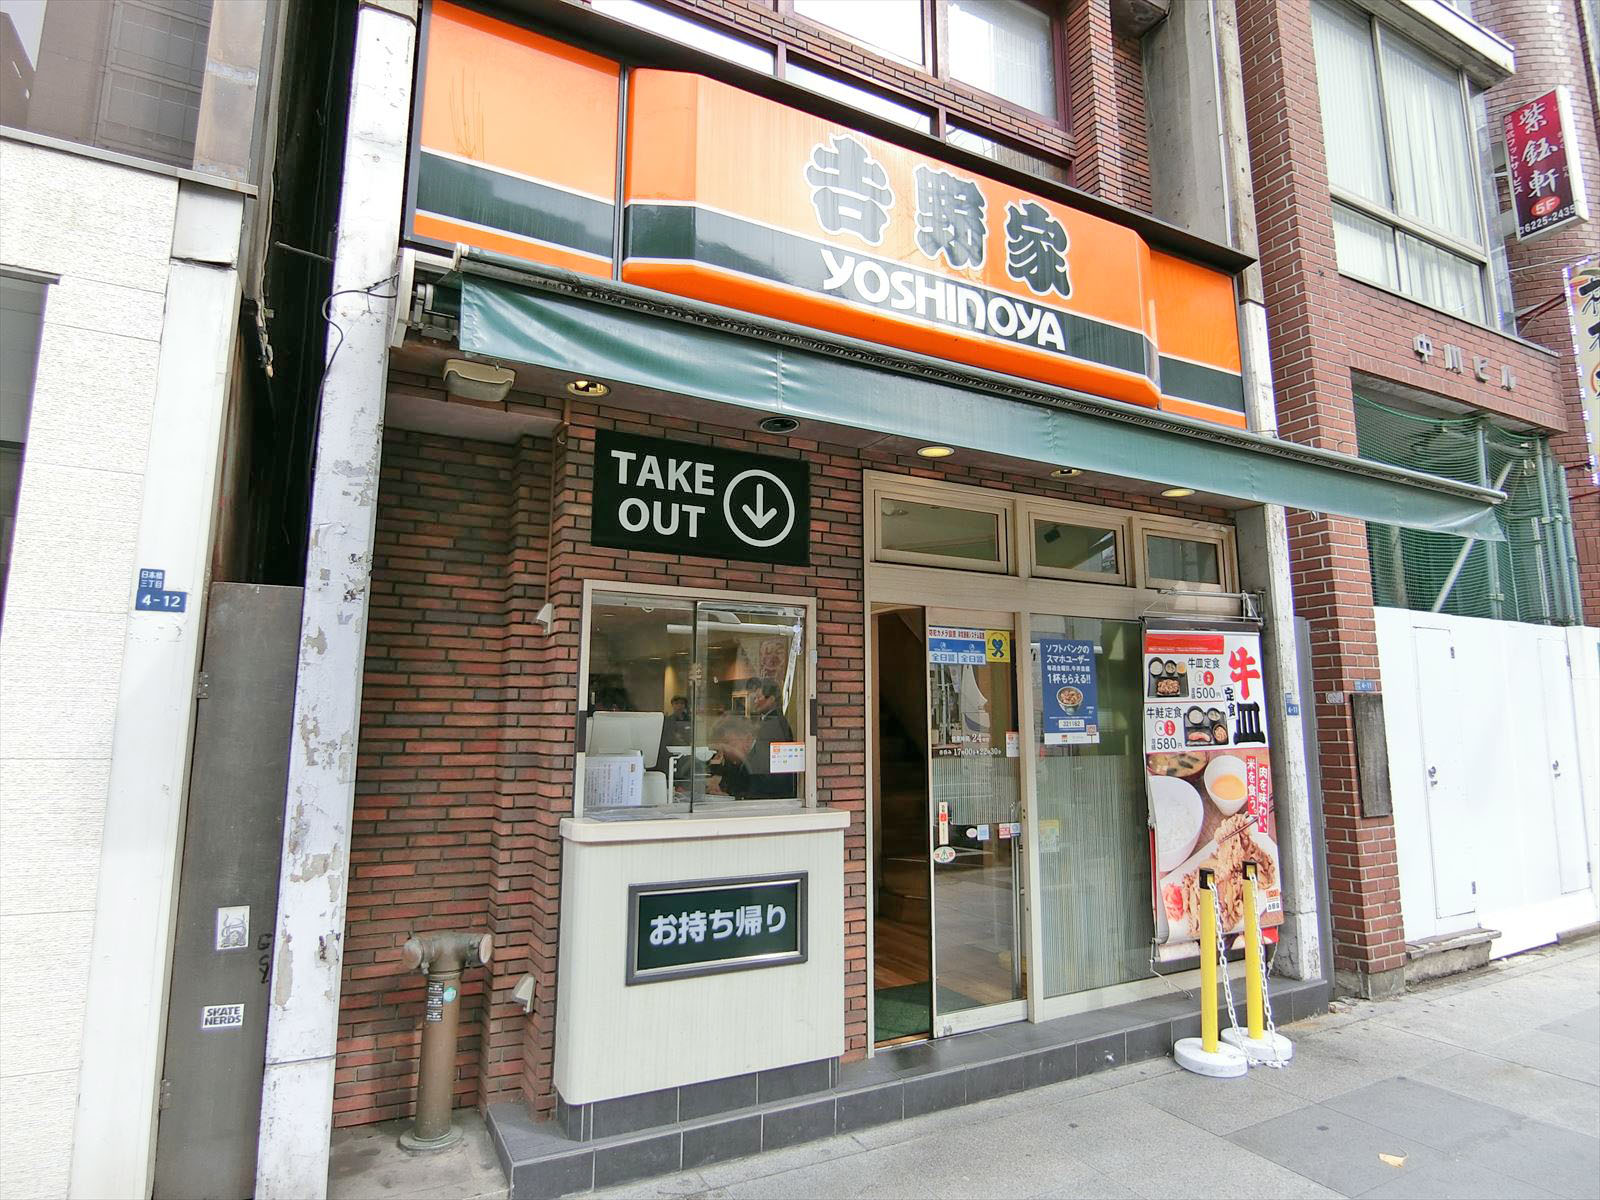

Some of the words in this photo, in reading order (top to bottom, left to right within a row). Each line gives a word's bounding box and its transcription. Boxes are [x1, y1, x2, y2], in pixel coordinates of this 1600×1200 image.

[1535, 197, 1556, 216] 5F
[804, 133, 1072, 300] 吉野家
[611, 450, 715, 496] TAKE
[618, 498, 705, 538] OUT
[140, 580, 162, 588] 三丁目
[142, 594, 181, 607] 4-12
[1045, 643, 1090, 654] ソフトバンクの
[1046, 654, 1090, 664] スマホユーザー
[1188, 657, 1220, 669] 牛皿定食
[1146, 706, 1182, 719] 牛鮭定食
[649, 904, 788, 946] お持ち帰り
[206, 1006, 241, 1017] SKATE
[204, 1015, 242, 1026] NERDS
